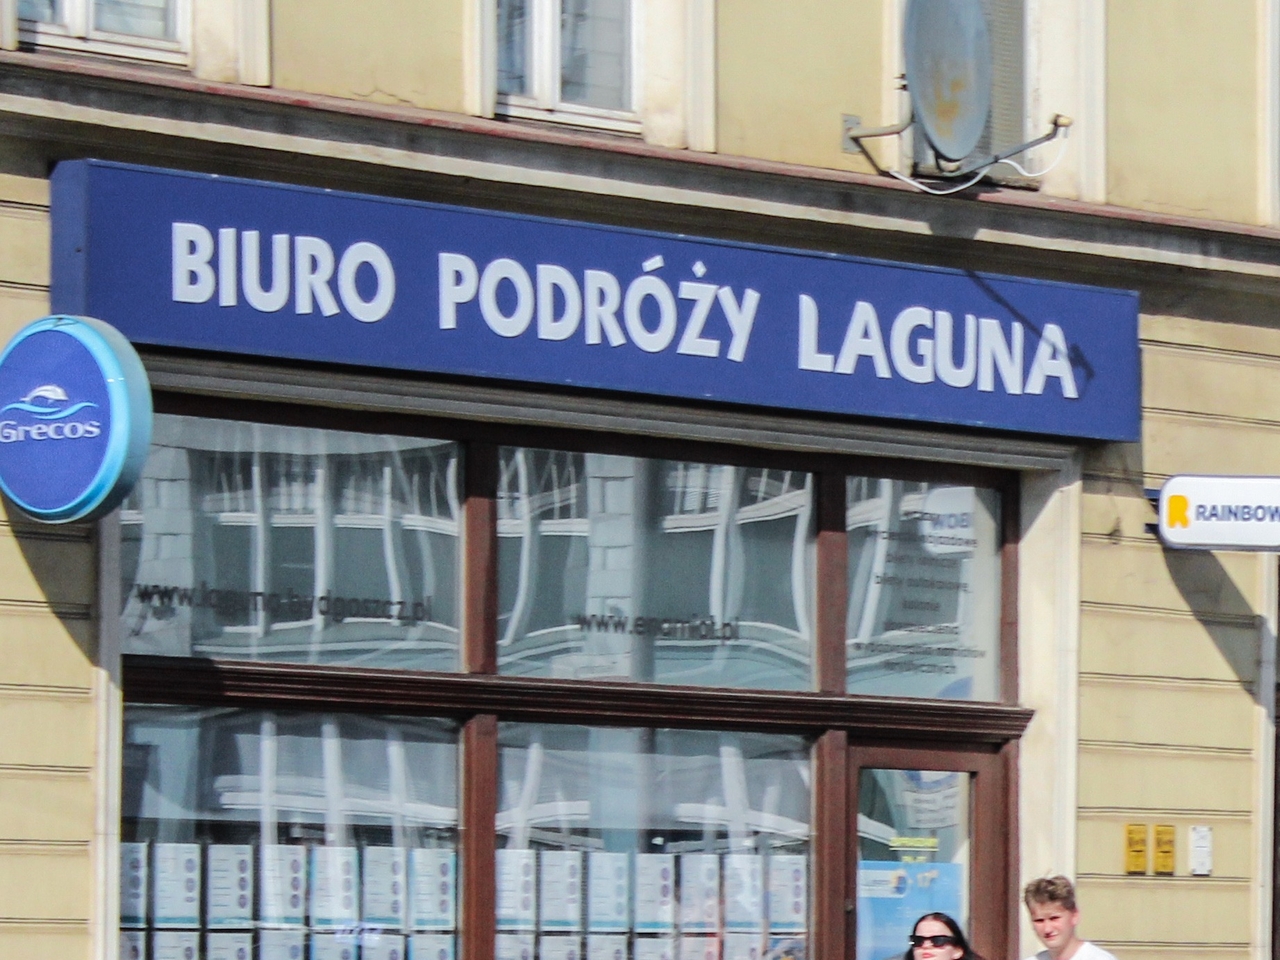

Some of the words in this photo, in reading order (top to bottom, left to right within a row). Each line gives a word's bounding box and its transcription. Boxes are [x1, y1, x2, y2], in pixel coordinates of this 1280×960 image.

[172, 222, 396, 323] BIURO
[438, 253, 761, 363] PODRÓŻY
[798, 294, 1080, 399] LAGUNA
[0, 420, 101, 442] Grecos
